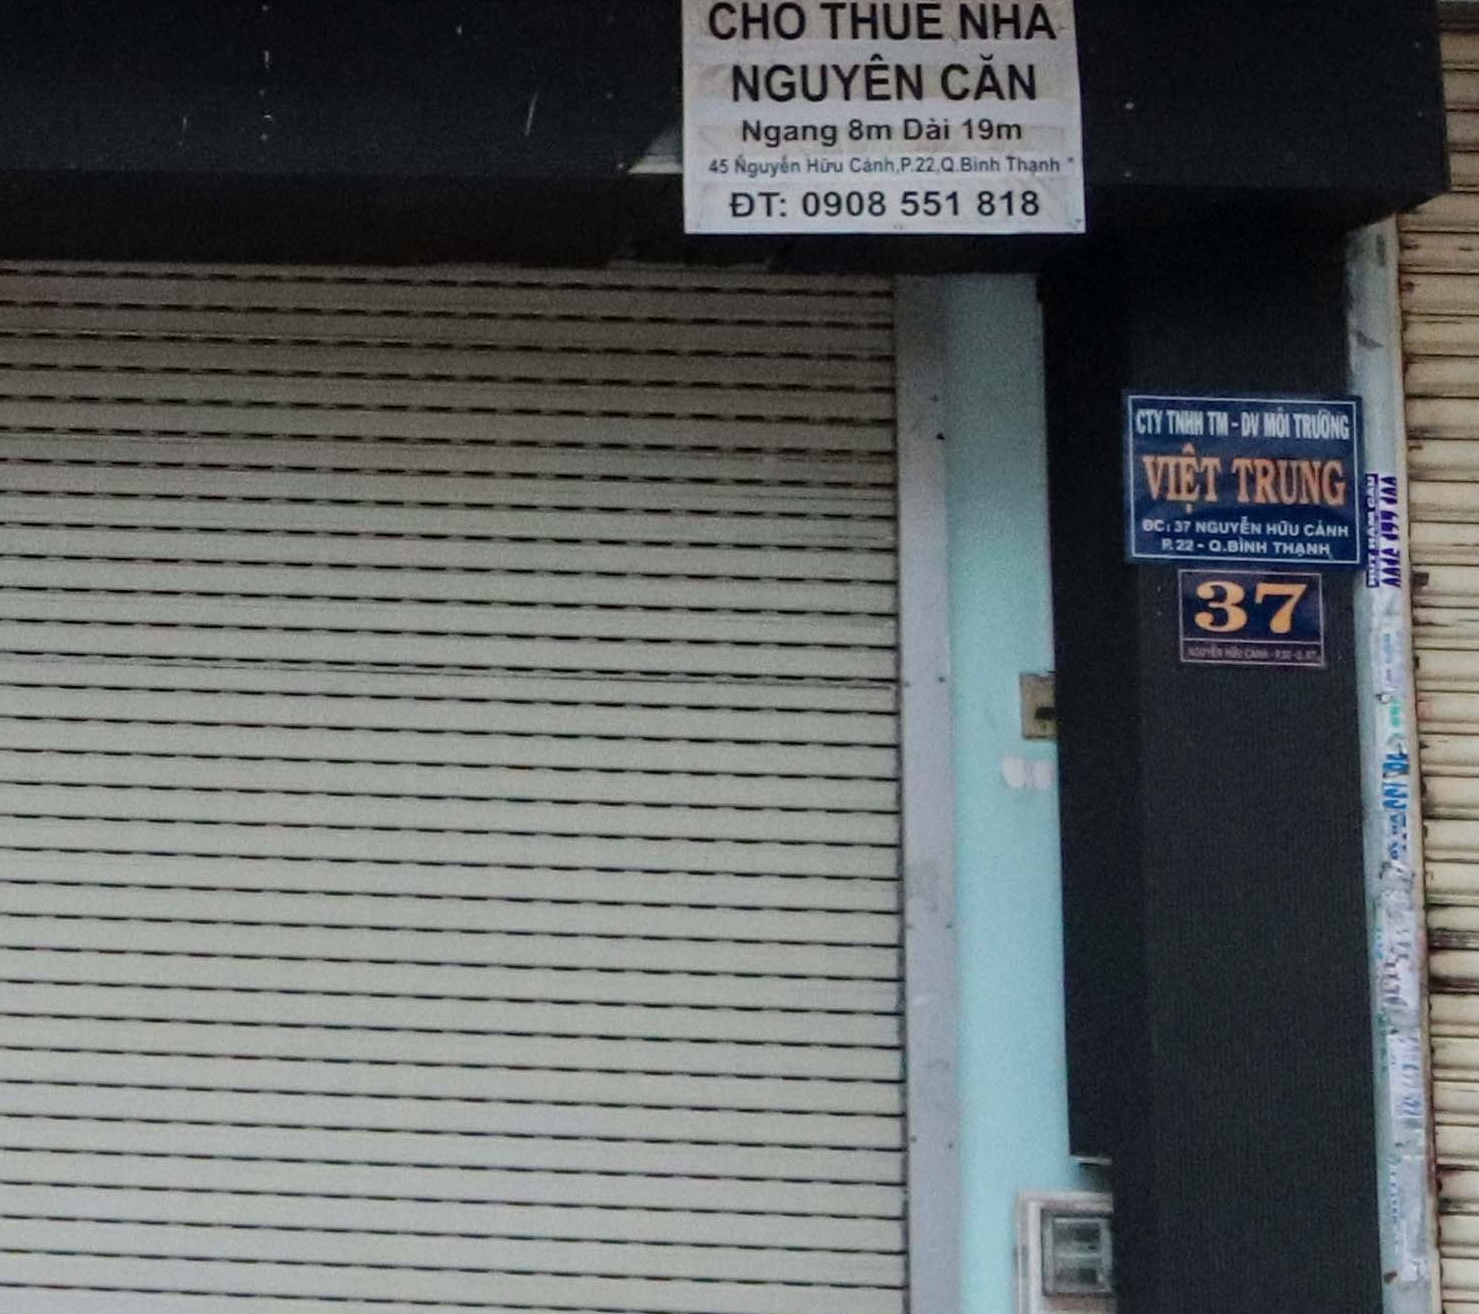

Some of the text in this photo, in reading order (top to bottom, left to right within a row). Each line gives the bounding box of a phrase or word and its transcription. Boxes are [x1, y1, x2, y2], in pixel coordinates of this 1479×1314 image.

[709, 1, 806, 40] CHO
[731, 53, 1037, 102] NGUYÊN CĂN
[742, 117, 1023, 148] Ngang 8m Dài 19m
[708, 158, 729, 174] 45
[807, 157, 843, 173] Hữu
[1006, 156, 1060, 176] Thạnh
[729, 190, 1040, 217] ĐT: 0908 551 818
[1136, 409, 1162, 435] CTY
[1166, 410, 1203, 435] TNHH
[1207, 411, 1228, 435] TM
[1242, 412, 1259, 437] DV
[1264, 407, 1290, 438] MÔI
[1142, 443, 1346, 513] VIỆT TRUNG
[1174, 520, 1191, 533] 37
[1195, 516, 1262, 534] NGUYỄN
[1266, 521, 1299, 536] HỮU
[1304, 520, 1349, 537] CẢNH
[1273, 541, 1331, 556] THẠNH
[1194, 581, 1308, 634] 37
